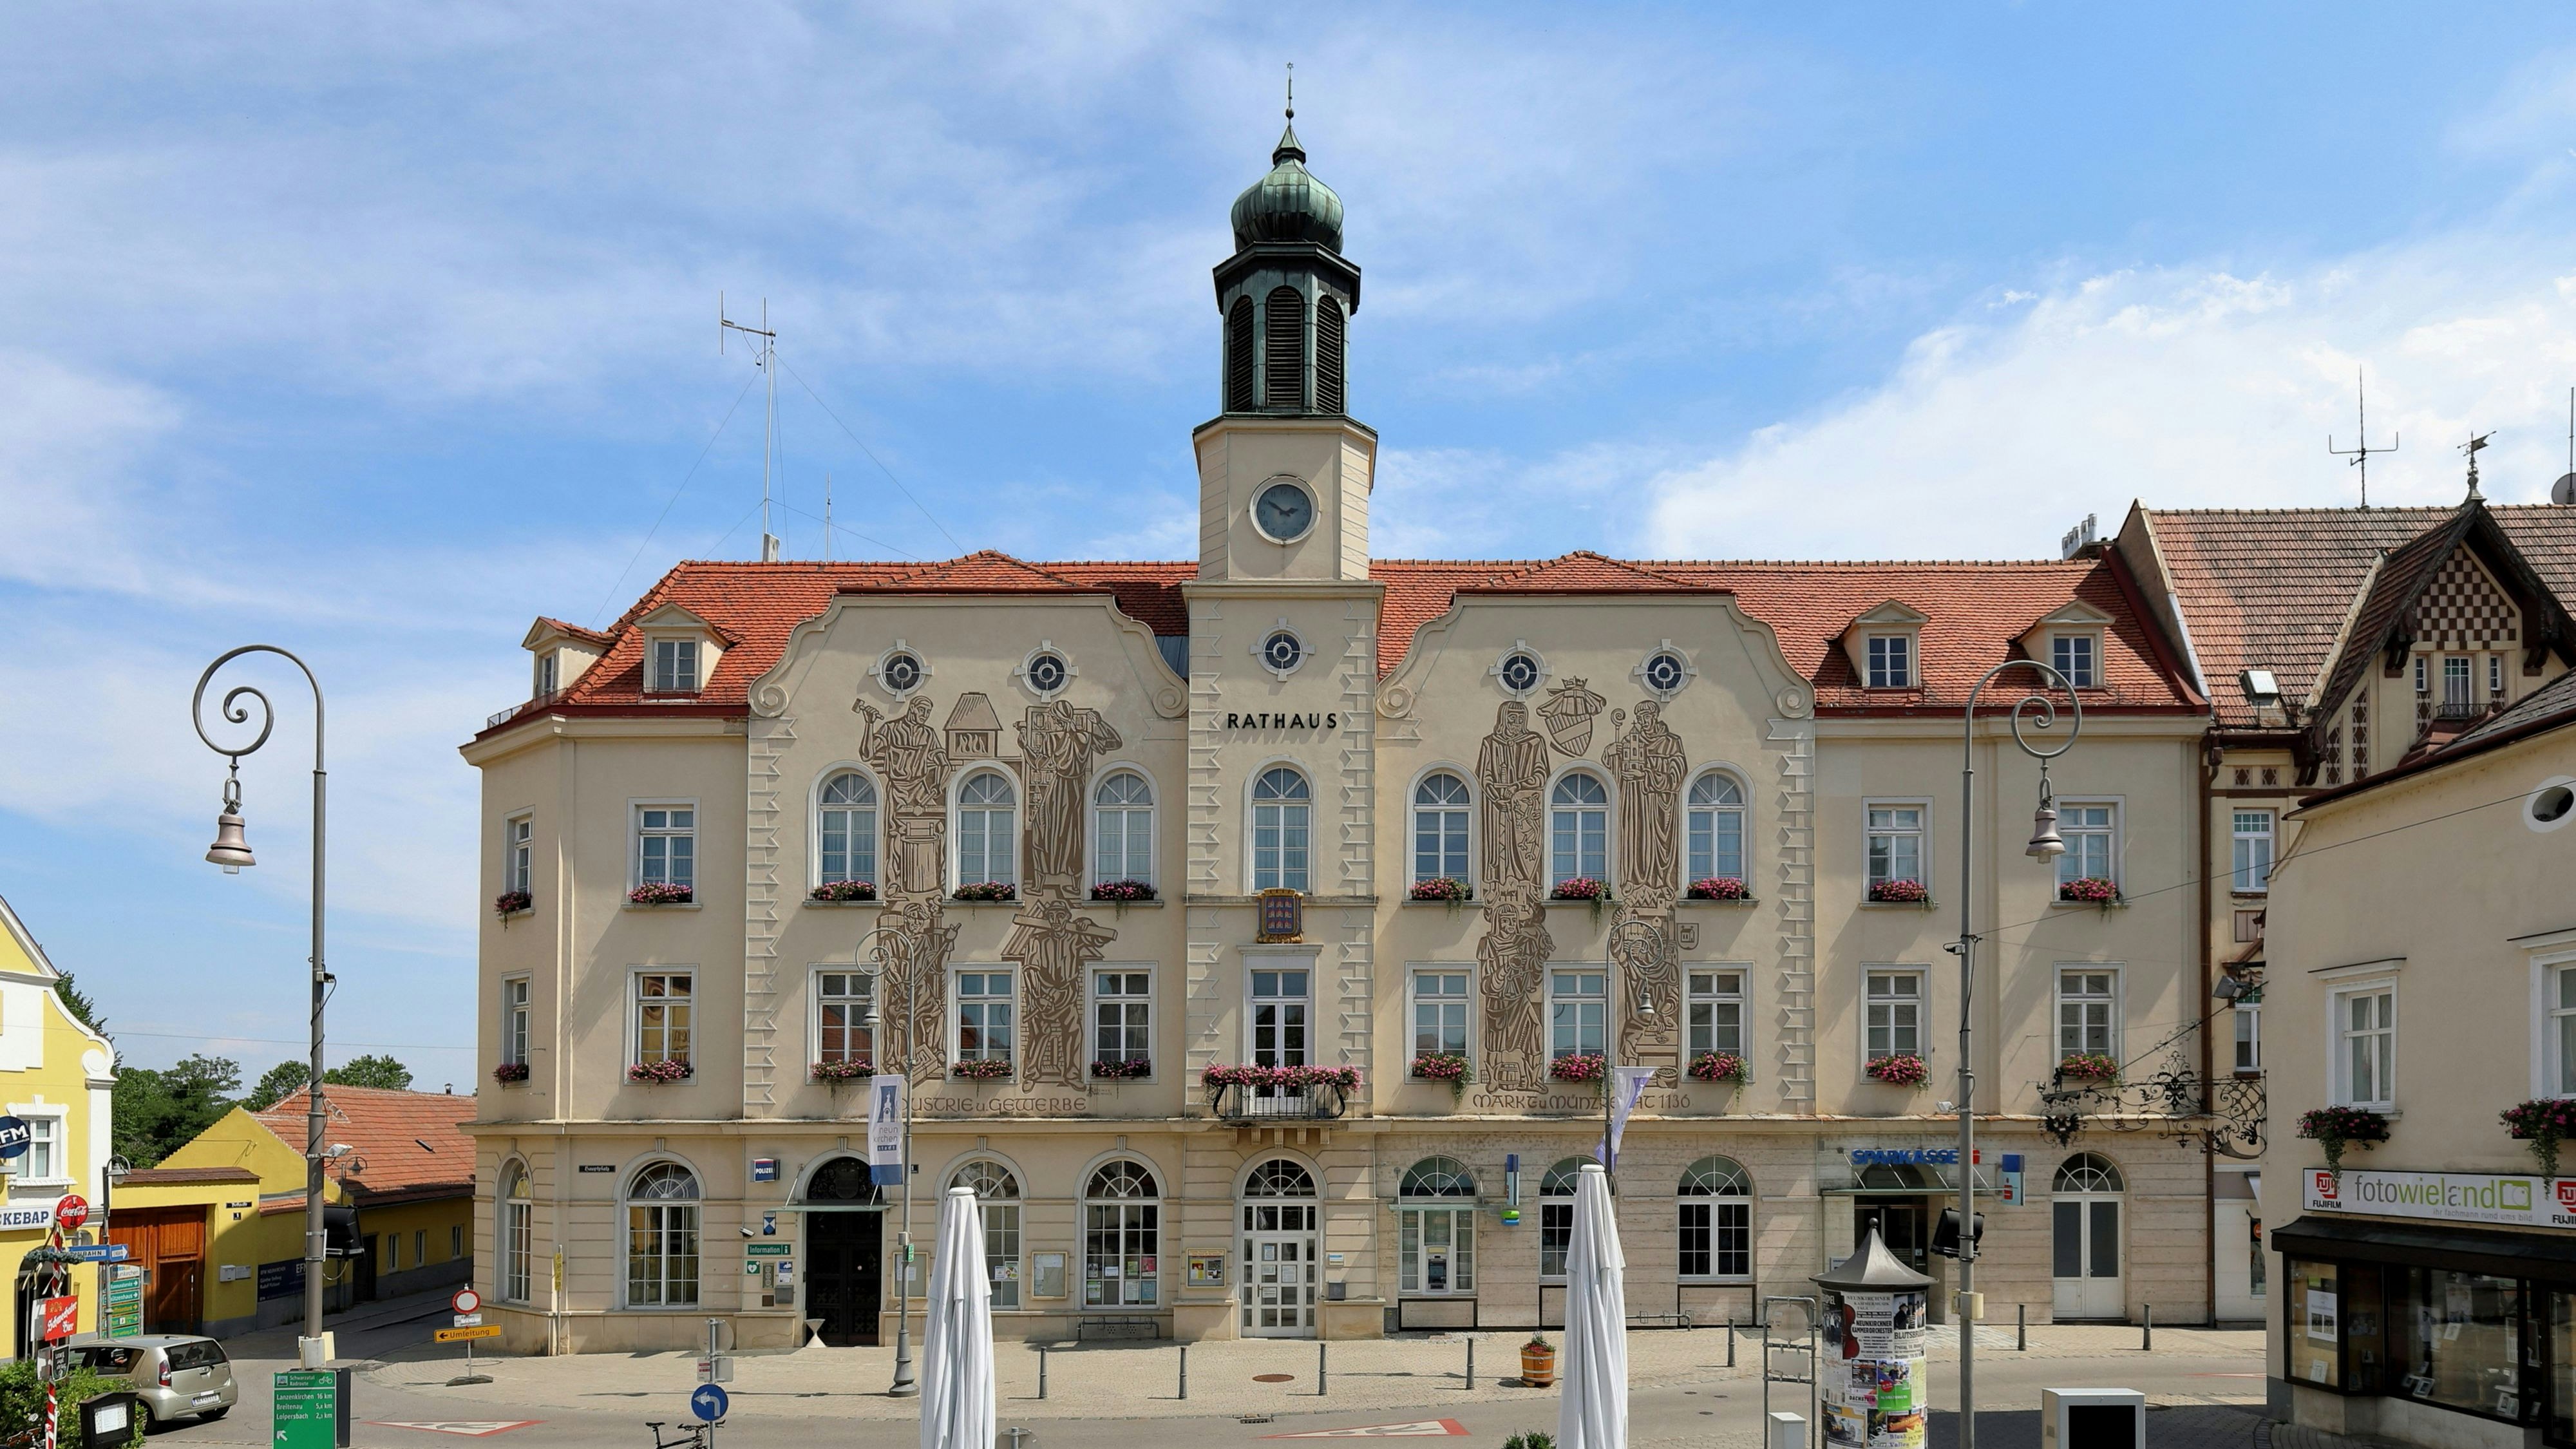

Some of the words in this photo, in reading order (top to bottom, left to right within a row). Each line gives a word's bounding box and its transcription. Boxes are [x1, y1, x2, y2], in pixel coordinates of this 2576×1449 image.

[1227, 713, 1337, 729] RATHAUS
[989, 1097, 1086, 1113] GEWERBE
[1473, 1094, 1538, 1109] MARKT
[1660, 1094, 1690, 1109] 1136
[0, 1124, 29, 1144] FM
[1852, 1149, 1959, 1165] SPARKASSE
[2313, 1200, 2342, 1209] FUJIFILM
[0, 1211, 49, 1226] KEBAP
[2445, 1209, 2479, 1218] fachmann
[2519, 1214, 2533, 1222] bild
[2552, 1214, 2576, 1224] FUJI
[749, 1245, 781, 1254] Information
[450, 1329, 489, 1339] Umleitung
[1849, 1394, 1875, 1403] DACHSTEIN
[276, 1412, 308, 1421] Loipersbach
